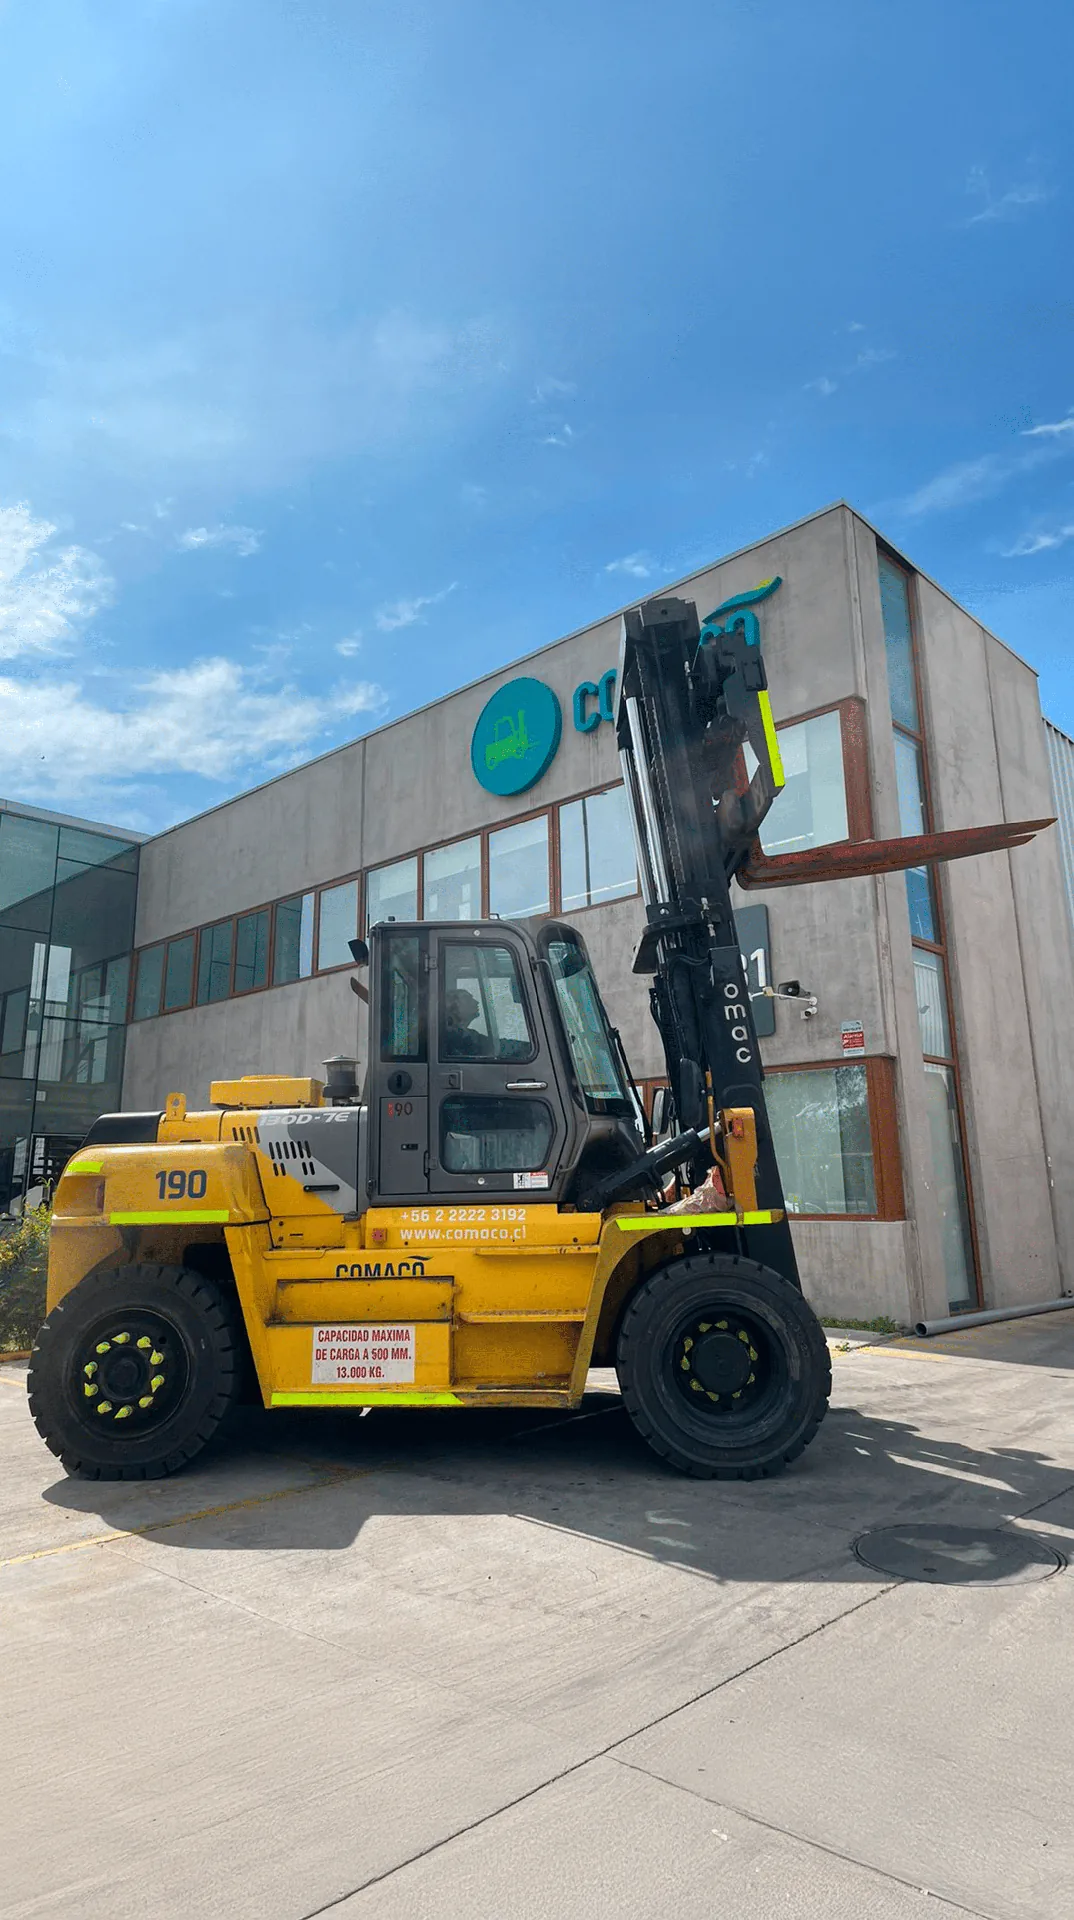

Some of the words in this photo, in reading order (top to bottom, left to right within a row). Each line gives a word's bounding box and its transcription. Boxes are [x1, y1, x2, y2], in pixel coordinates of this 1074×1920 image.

[258, 1111, 350, 1127] 130D-7E
[155, 1169, 207, 1200] 190
[400, 1209, 430, 1223] +56
[435, 1209, 444, 1222] 2
[448, 1209, 486, 1221] 2222
[490, 1208, 526, 1221] 3192
[400, 1225, 527, 1240] www.comaco.cl
[318, 1330, 369, 1342] CAPACIDAD
[371, 1329, 411, 1342] MAXIMA
[315, 1348, 328, 1361] DE
[329, 1348, 360, 1361] CARGA
[362, 1348, 370, 1360] A
[371, 1347, 389, 1360] 500
[391, 1347, 412, 1360] MM.
[336, 1366, 367, 1379] 13.000
[369, 1366, 385, 1378] KG.
